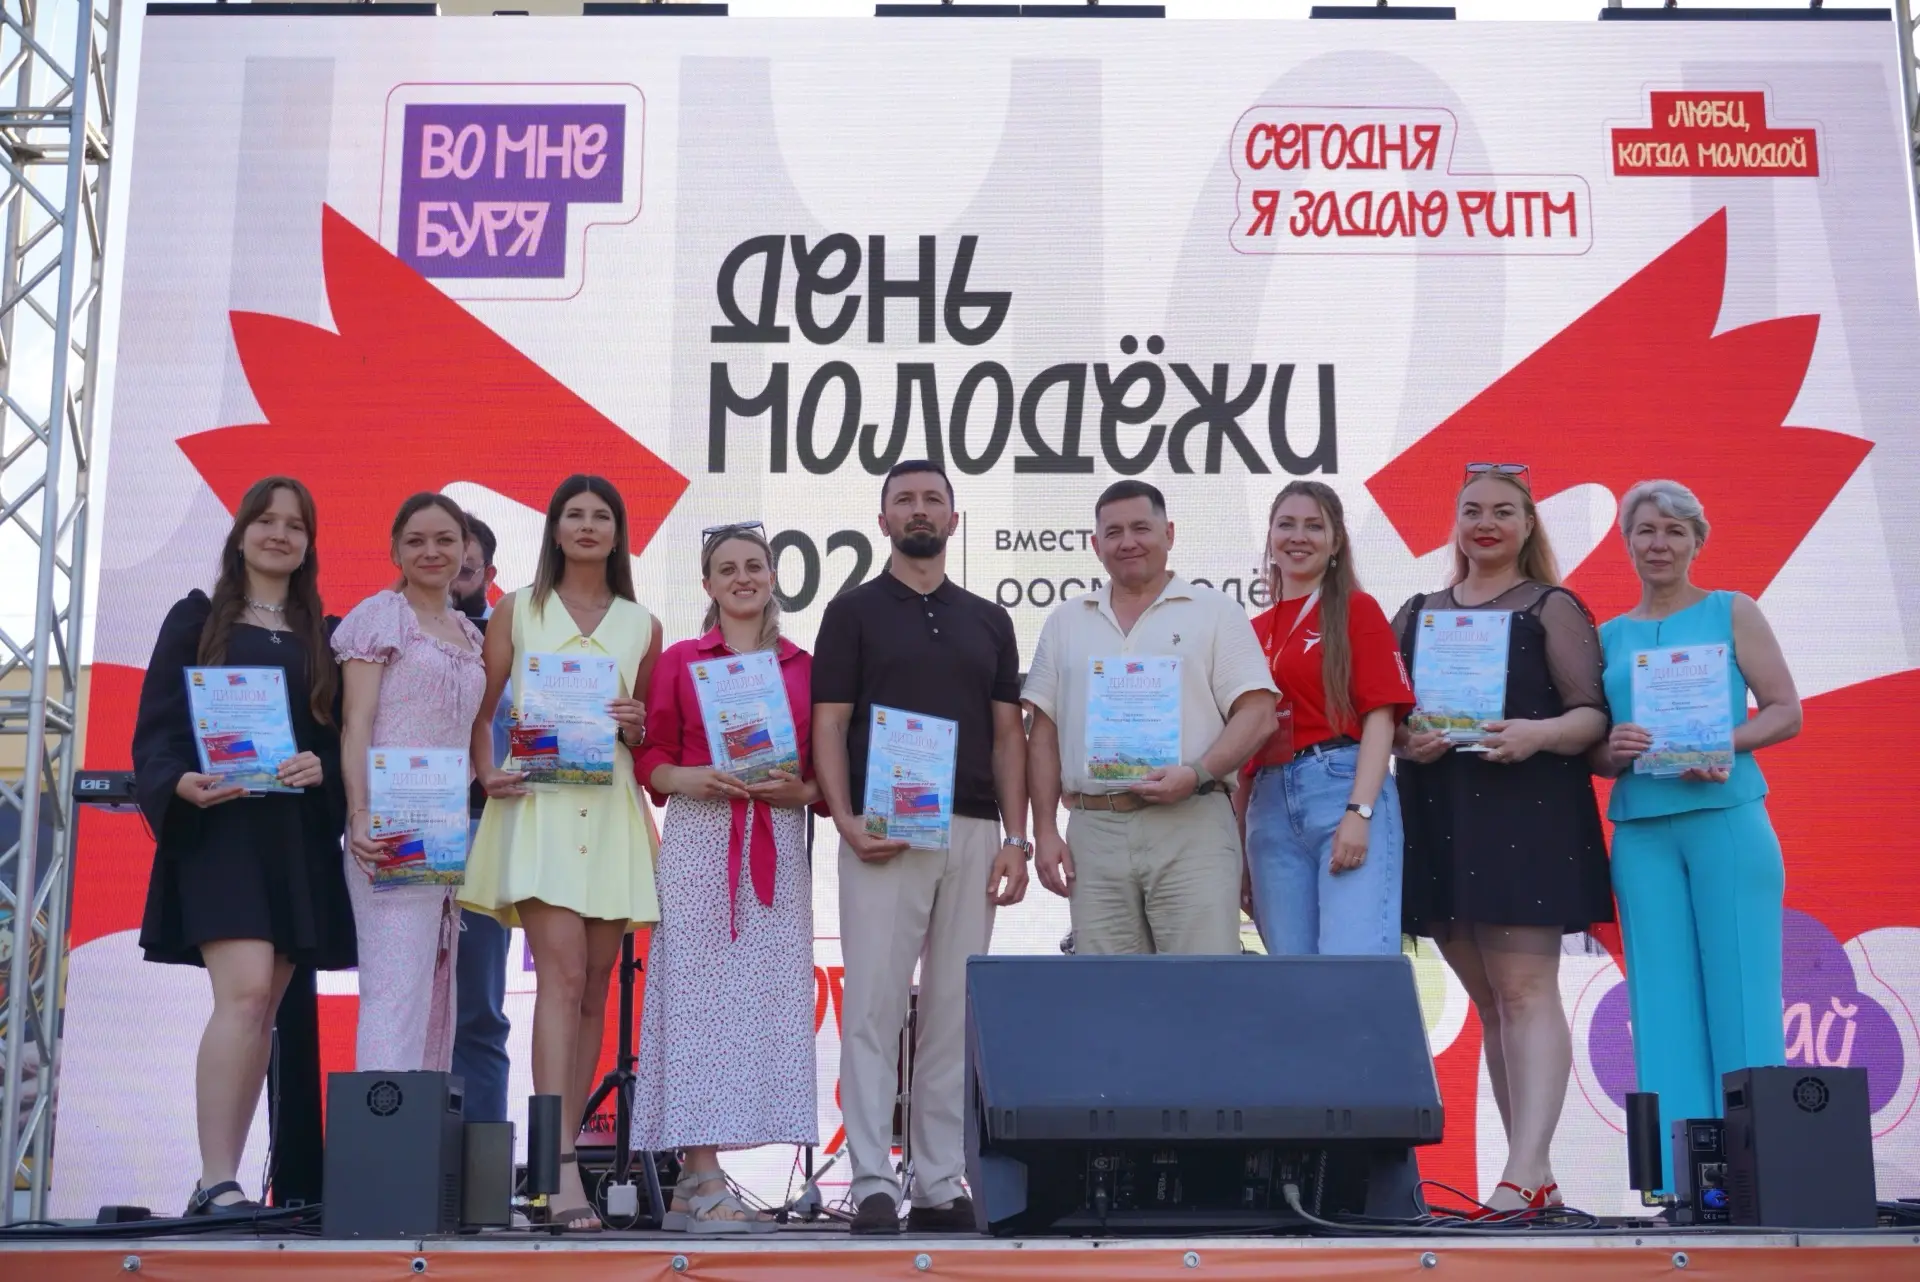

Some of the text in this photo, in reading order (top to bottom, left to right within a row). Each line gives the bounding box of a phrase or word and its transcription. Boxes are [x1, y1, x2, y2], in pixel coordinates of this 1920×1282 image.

[420, 123, 608, 180] ВО МНЕ
[1245, 123, 1441, 171] СЕГОДНЯ
[1619, 137, 1808, 169] КОГДА МОЛОДОЙ
[416, 202, 550, 258] БУРЯ
[1246, 190, 1577, 238] Я ЗАДАЮ РИТМ
[710, 232, 1012, 346] ДЕНЬ
[707, 334, 1339, 475] МОЛОДЁЖИ
[995, 529, 1094, 552] вмест
